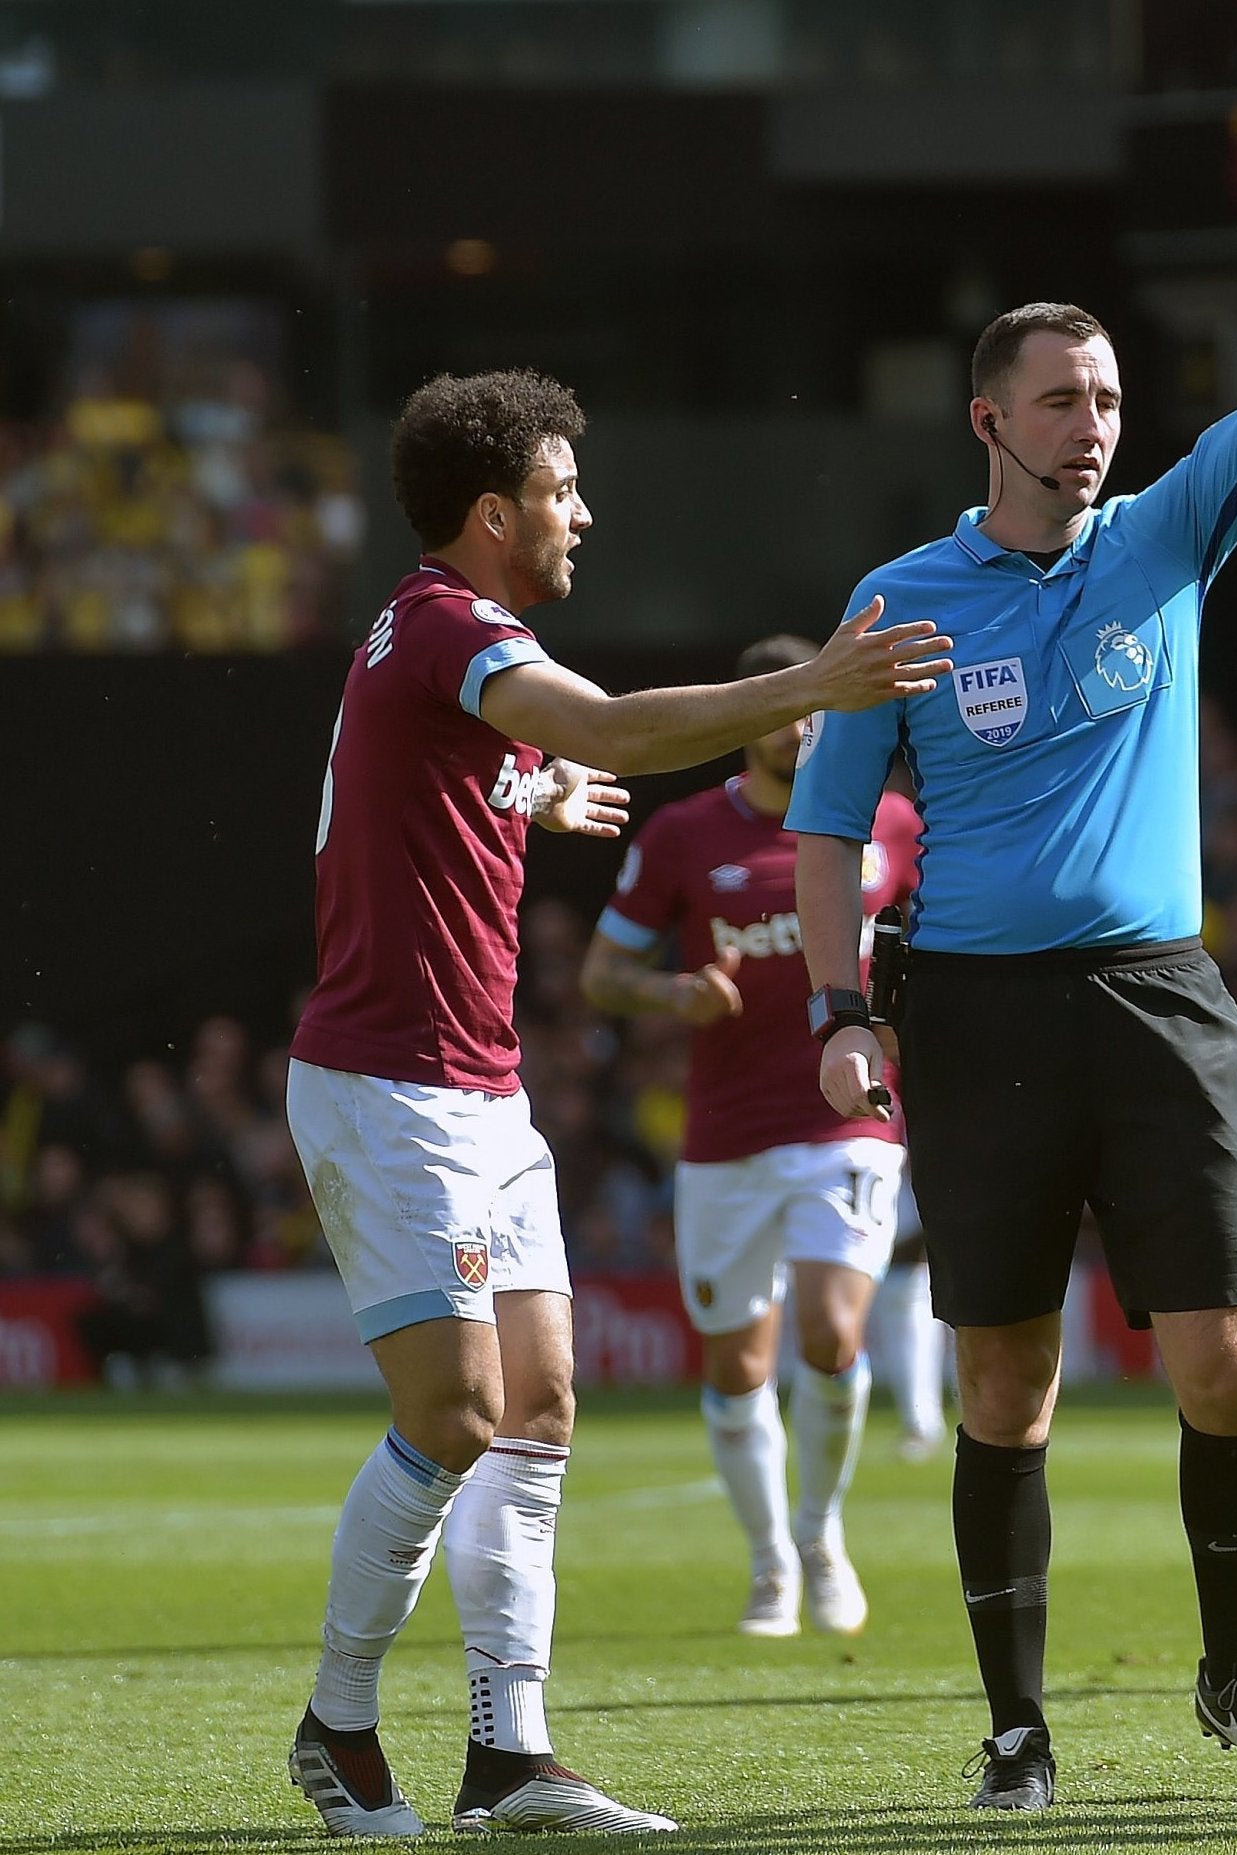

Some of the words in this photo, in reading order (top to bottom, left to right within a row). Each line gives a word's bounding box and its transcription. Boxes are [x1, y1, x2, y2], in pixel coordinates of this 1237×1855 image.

[959, 665, 1018, 693] FIFA
[966, 696, 1023, 717] REFEREE
[986, 726, 1012, 740] 2019
